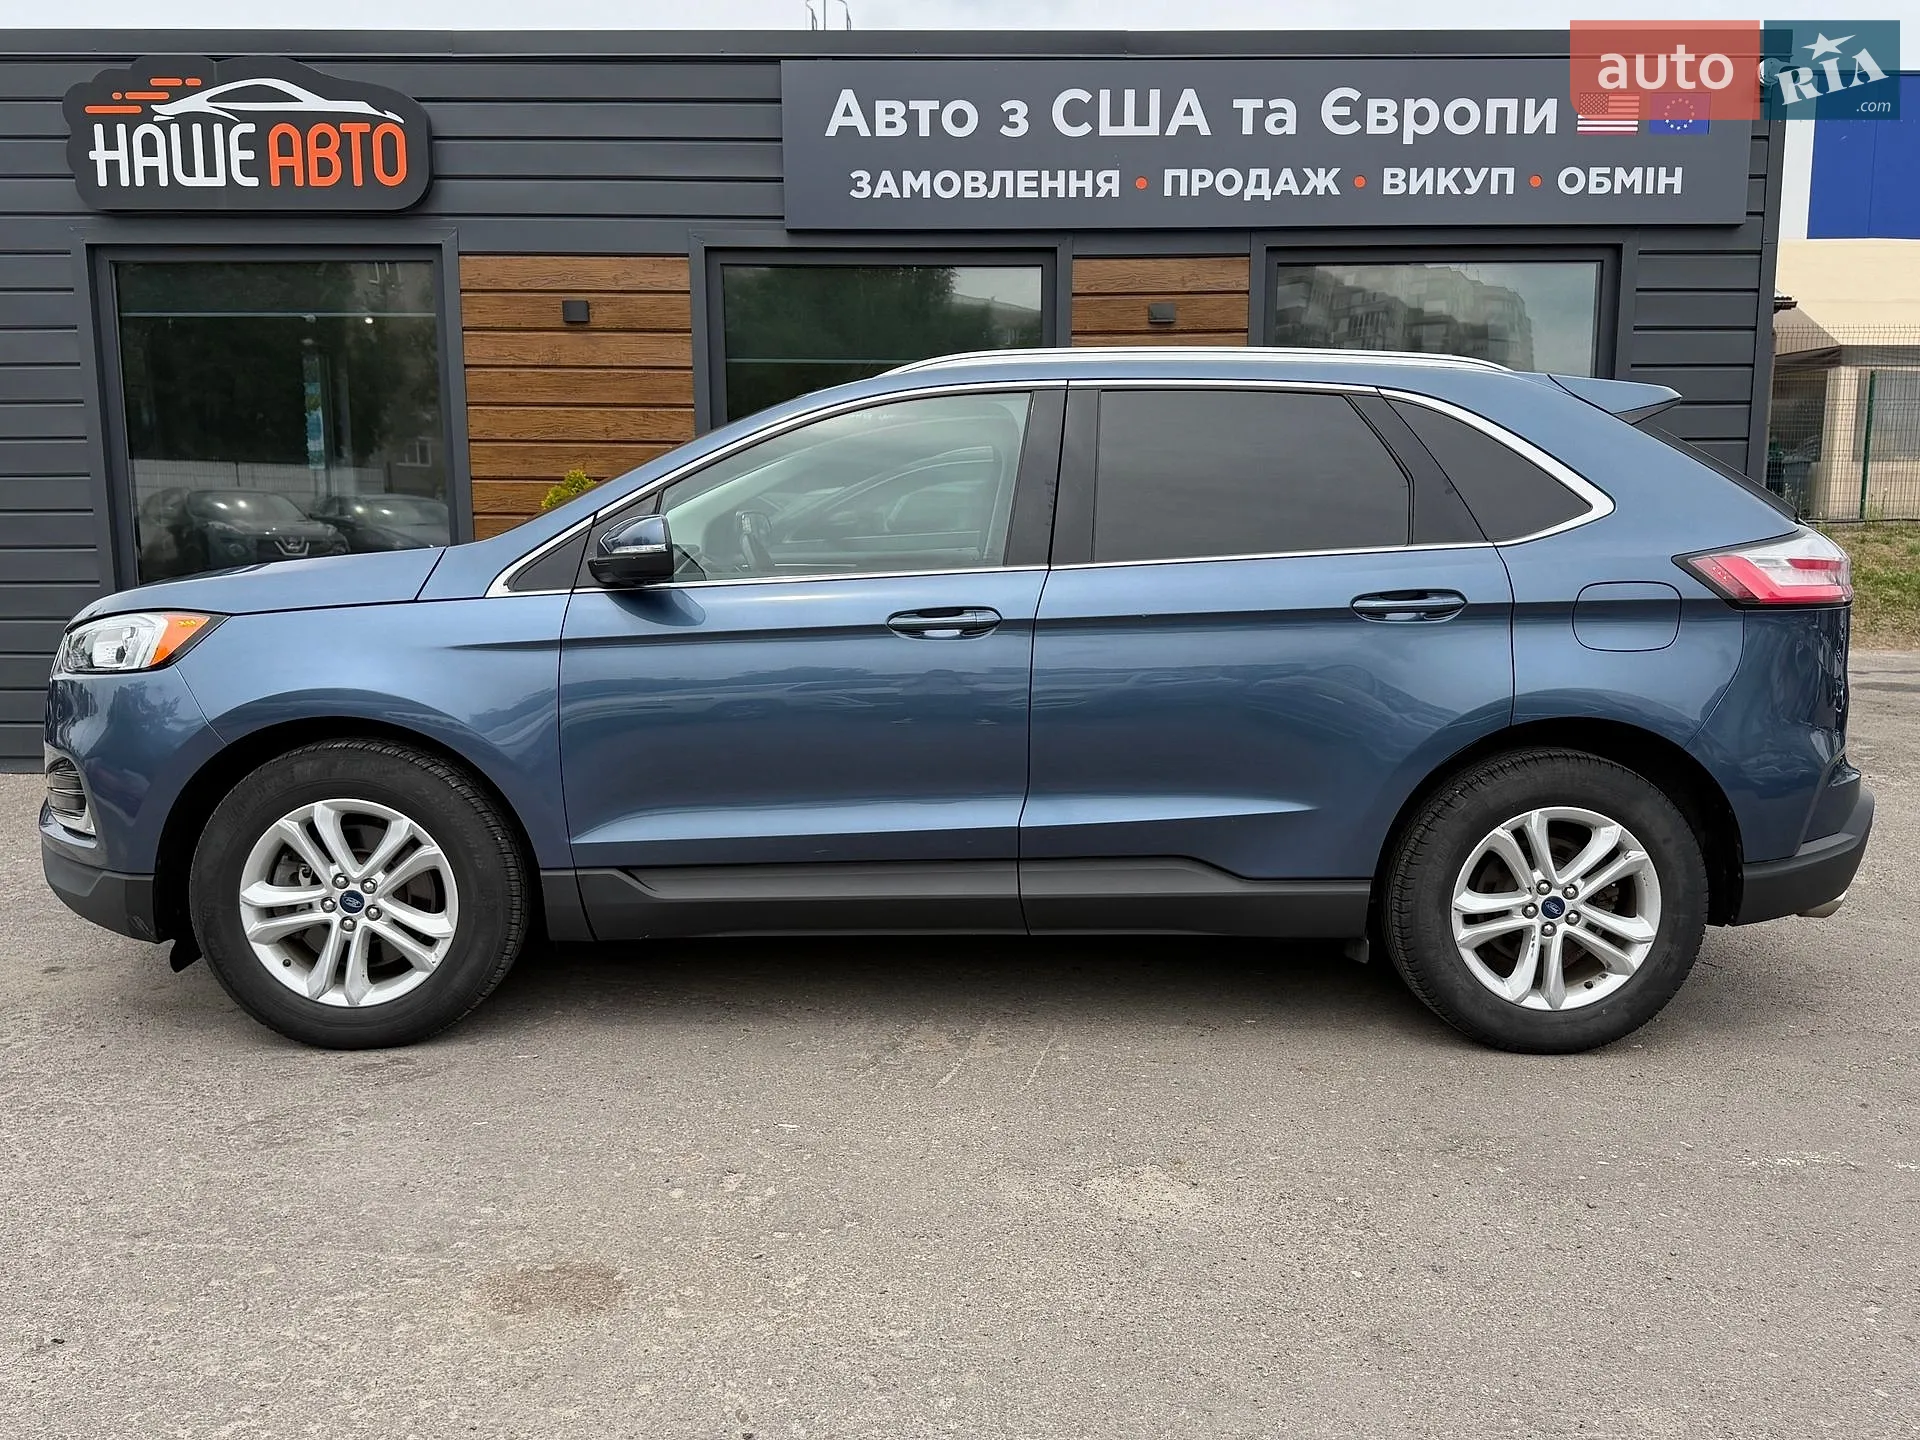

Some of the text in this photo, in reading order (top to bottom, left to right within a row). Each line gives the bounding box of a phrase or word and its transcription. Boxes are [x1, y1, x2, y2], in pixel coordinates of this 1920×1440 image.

[825, 86, 1558, 145] Авто з США та Європи
[88, 122, 407, 187] НАШЕ АВТО
[849, 167, 1683, 202] ЗАМОВЛЕННЯ ПРОДАЖ ВИКУП ОБМІН
